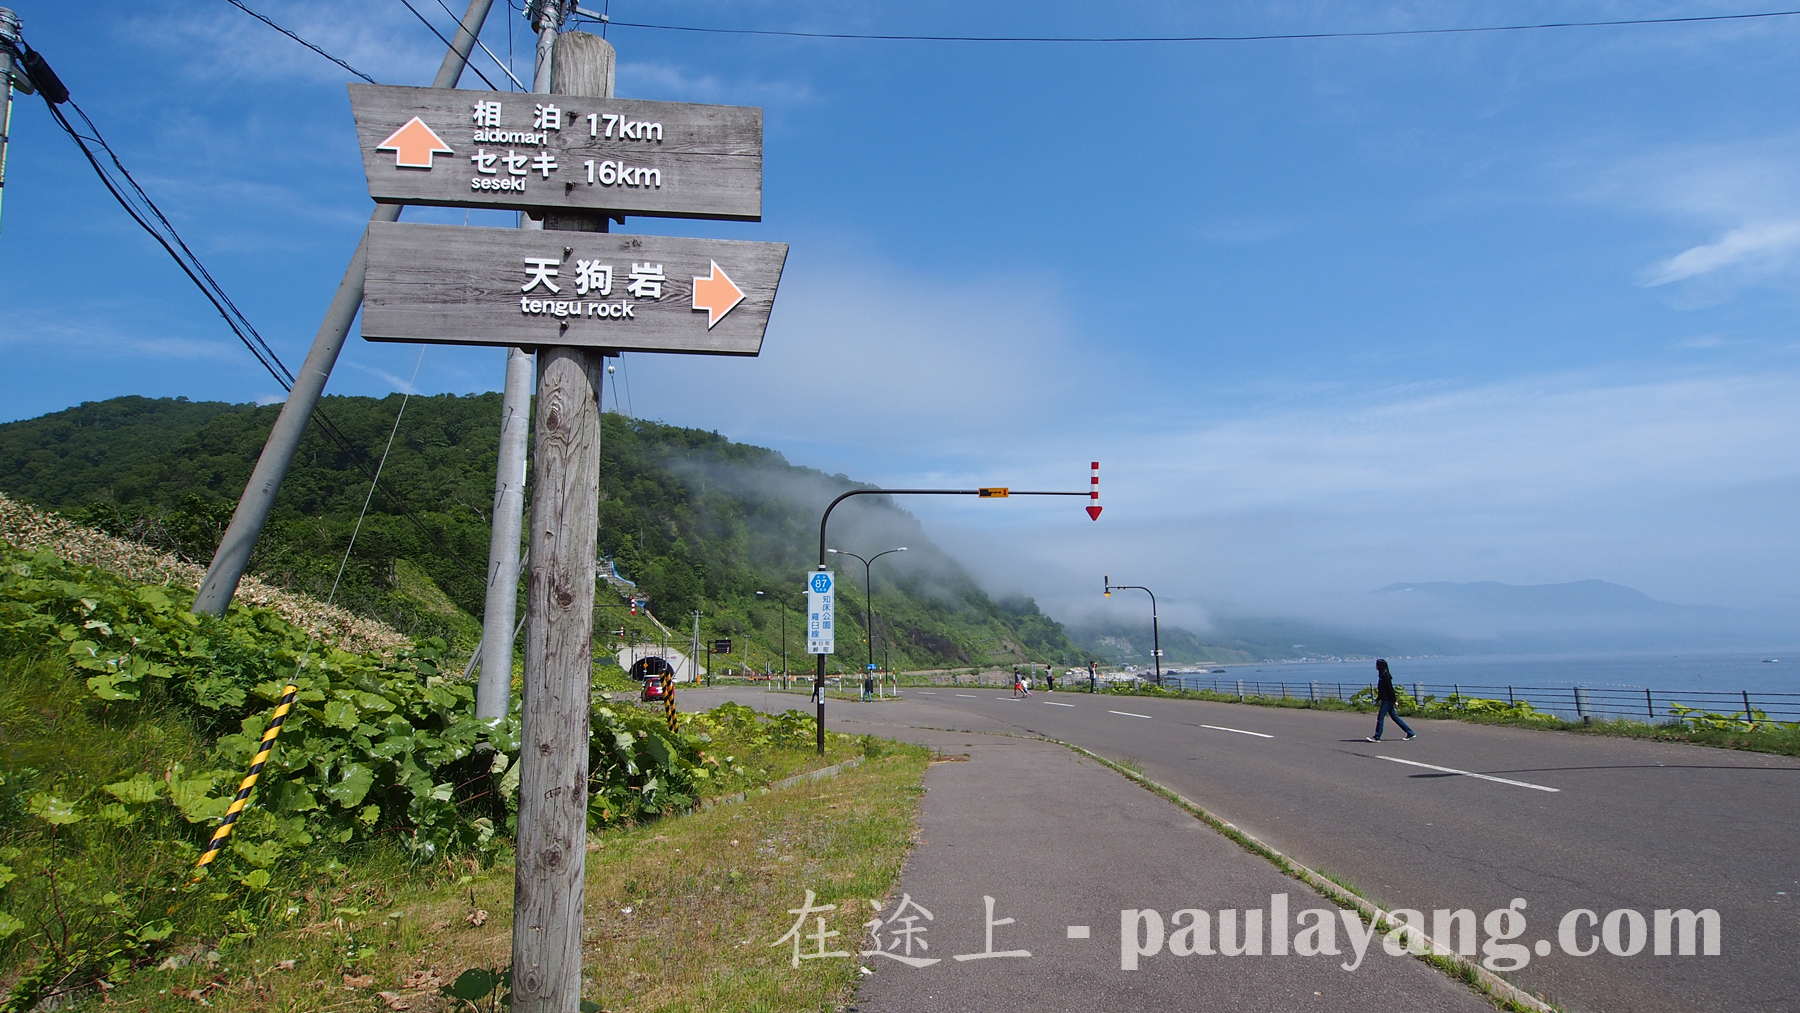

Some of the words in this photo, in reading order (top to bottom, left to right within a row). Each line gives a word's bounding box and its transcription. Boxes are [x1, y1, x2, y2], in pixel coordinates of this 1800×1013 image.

[473, 129, 548, 145] aidomari
[587, 114, 663, 141] 17km
[471, 149, 558, 178] セセキ
[584, 160, 661, 187] 16km
[471, 176, 526, 192] seseki
[521, 257, 665, 299] 天狗岩
[520, 296, 581, 317] tengu
[588, 300, 634, 318] rock
[815, 579, 827, 588] 87
[822, 595, 831, 629] 知床公園
